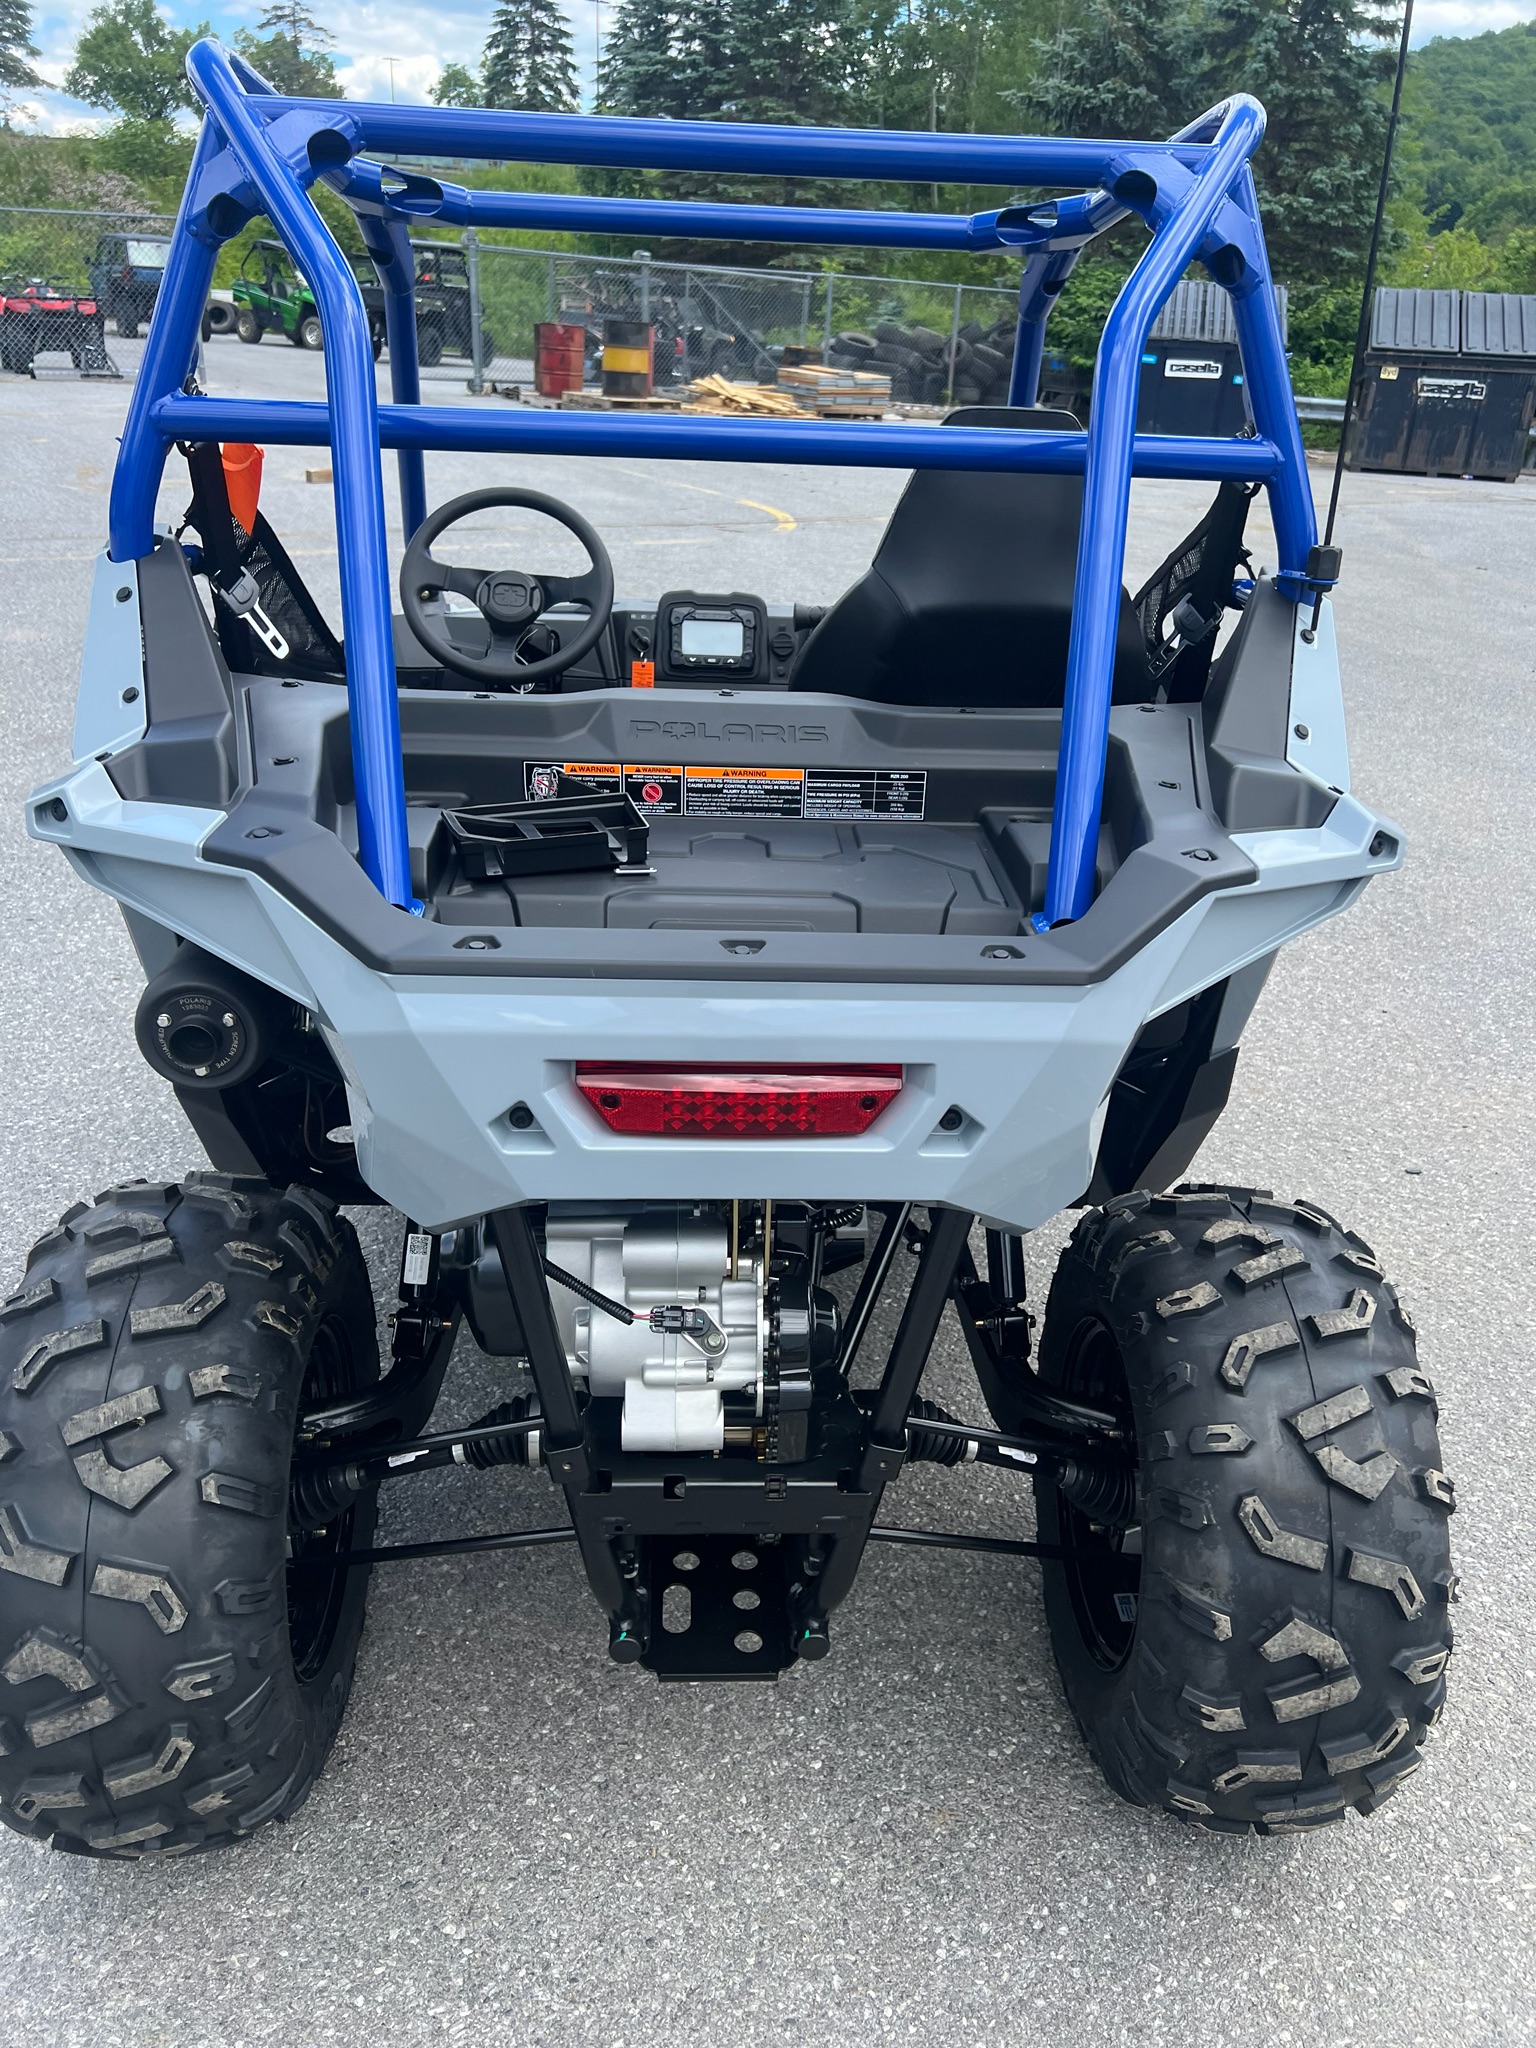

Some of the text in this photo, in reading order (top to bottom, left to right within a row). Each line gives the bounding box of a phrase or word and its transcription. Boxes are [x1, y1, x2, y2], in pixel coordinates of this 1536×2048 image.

[629, 719, 829, 743] POLARIS
[179, 998, 212, 1006] POLARIS
[215, 1031, 239, 1069] SCREEN TYPE
